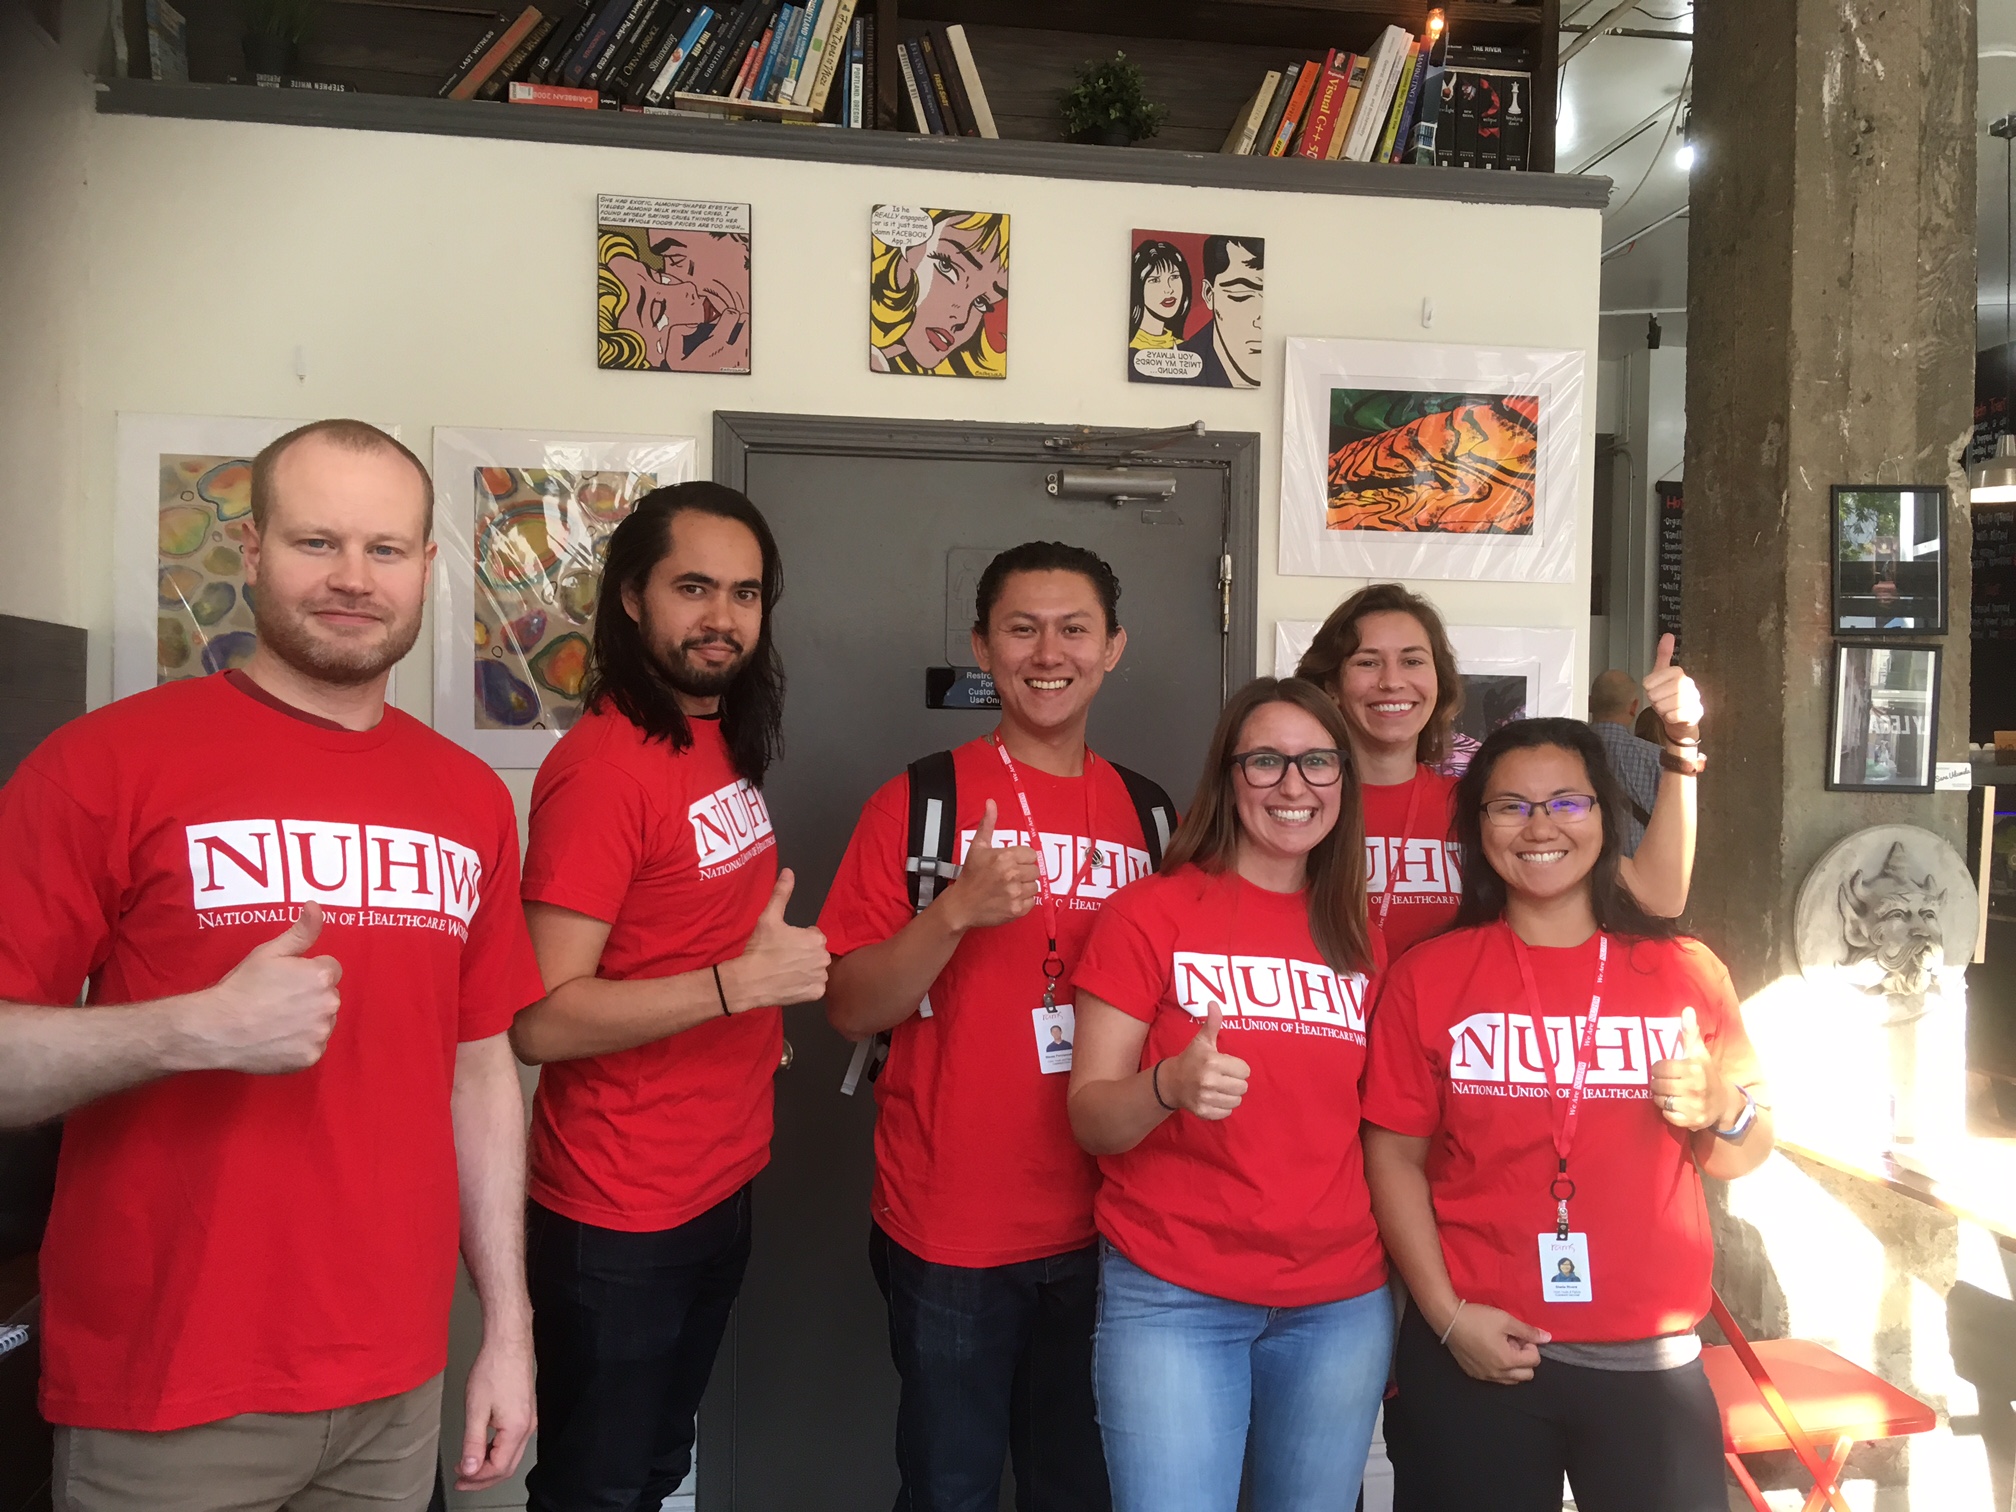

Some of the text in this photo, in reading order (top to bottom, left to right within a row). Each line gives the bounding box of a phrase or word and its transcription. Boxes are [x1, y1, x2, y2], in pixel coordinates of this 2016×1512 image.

[575, 29, 584, 42] City
[834, 13, 848, 35] From
[459, 31, 494, 70] LAST WITNESS
[624, 56, 640, 76] OPEN
[638, 25, 660, 56] MARRIAGE
[691, 42, 703, 57] KEEP
[826, 32, 843, 59] Tapas
[505, 48, 527, 71] DOUBLE
[704, 45, 725, 78] GHOSTING
[910, 41, 924, 76] ISLAND
[291, 80, 344, 92] STEPHEN WHITE
[818, 64, 833, 88] Meze
[933, 73, 944, 91] FIRST
[1408, 52, 1425, 98] MARKETING
[553, 93, 593, 103] CARIBBEAN
[1319, 78, 1340, 115] Visual
[1312, 115, 1327, 142] C++
[1358, 106, 1373, 137] Biochemistry
[1273, 140, 1282, 155] USED
[654, 201, 707, 210] ALMOND-SHAPED
[891, 230, 927, 238] FACEBOOK
[897, 221, 910, 229] just
[194, 832, 481, 905] NUHW
[699, 857, 740, 881] NATIONAL
[1044, 889, 1049, 900] We
[1069, 898, 1101, 911] HEALT
[1392, 895, 1455, 905] HEALTHCARE
[197, 906, 445, 931] NATIONAL OF HEALTHCARE
[1597, 972, 1603, 983] We
[1242, 1018, 1278, 1031] UNION
[1281, 1022, 1293, 1032] OF
[1295, 1022, 1354, 1042] HEALTHCARE
[1584, 995, 1600, 1047] We Are NUHW
[1452, 1082, 1507, 1096] NATIONAL
[1569, 1062, 1587, 1116] We Are NUHW
